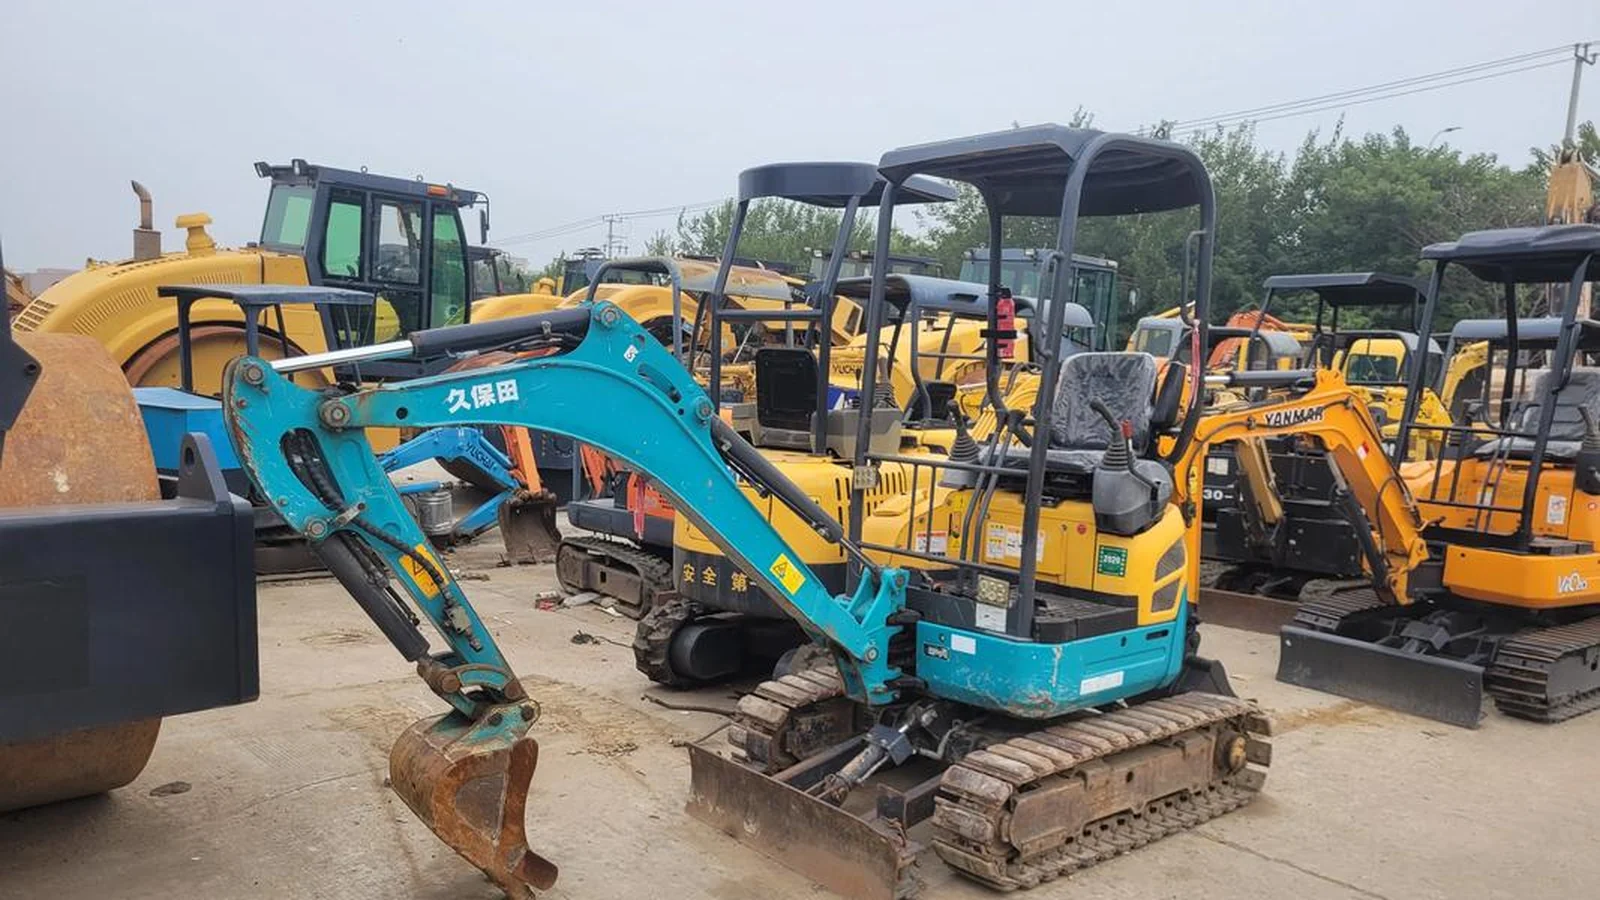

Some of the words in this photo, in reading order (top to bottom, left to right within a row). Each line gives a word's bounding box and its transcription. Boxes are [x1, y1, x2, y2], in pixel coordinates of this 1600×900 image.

[446, 379, 519, 413] 久保田
[1264, 406, 1324, 427] YANMAR
[465, 441, 495, 471] YUCHAI
